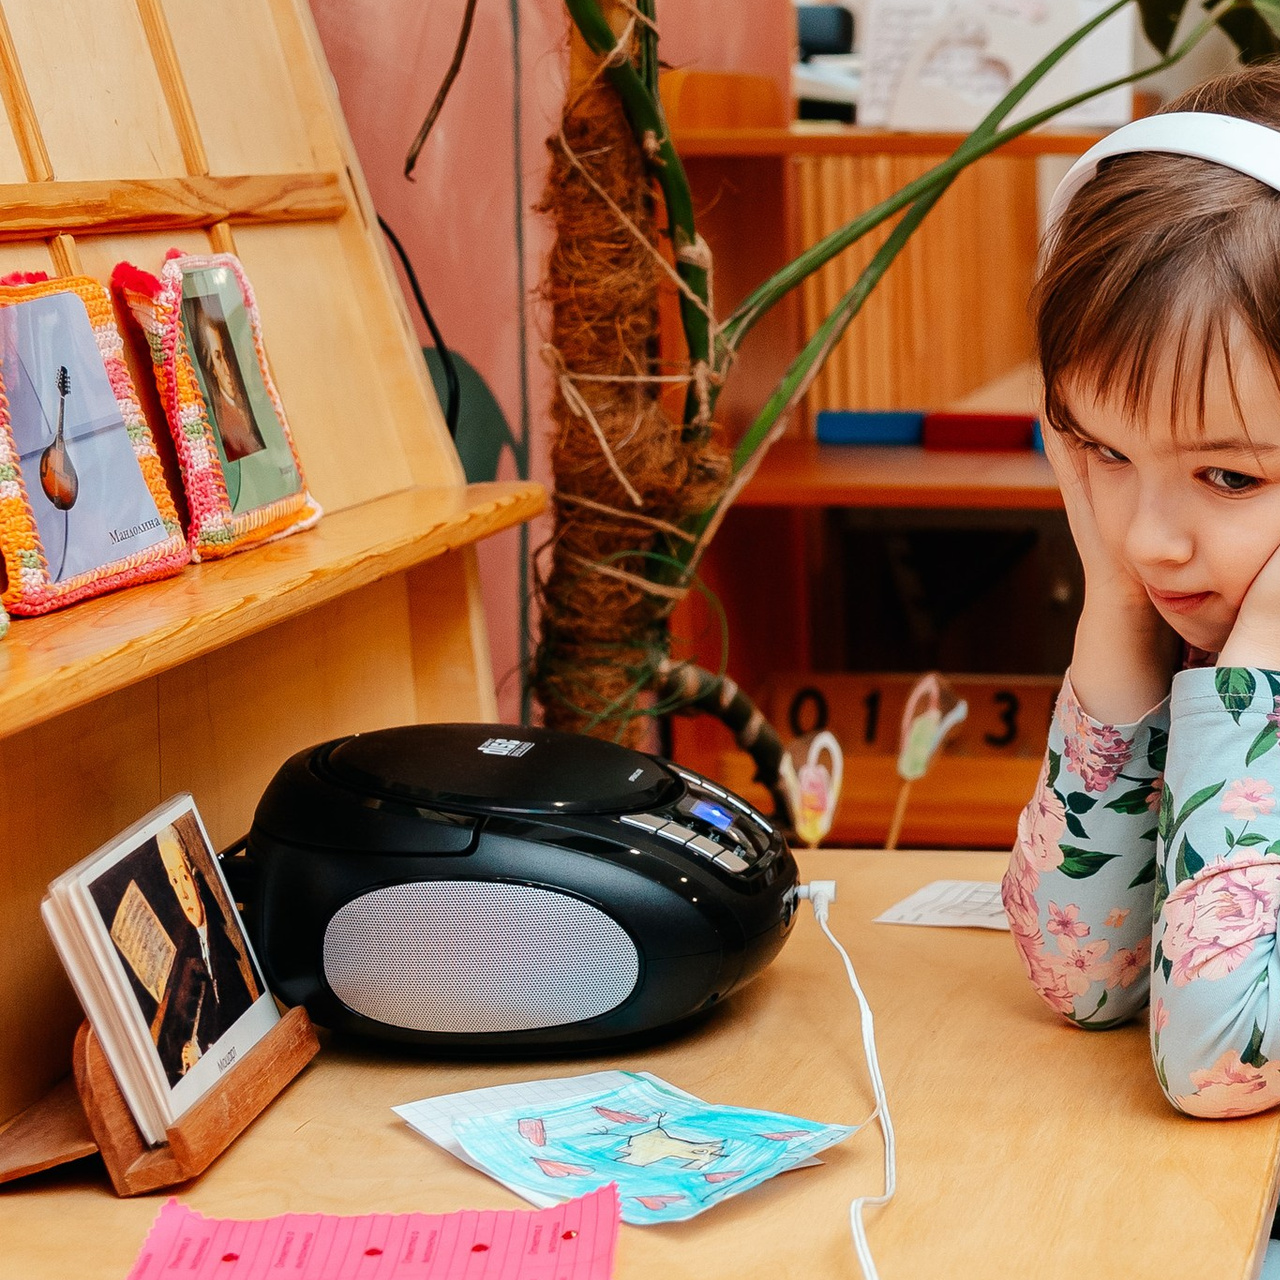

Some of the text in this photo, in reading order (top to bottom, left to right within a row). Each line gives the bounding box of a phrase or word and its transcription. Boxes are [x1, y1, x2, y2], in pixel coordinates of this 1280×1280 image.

[108, 517, 161, 545] Мандолина
[789, 687, 828, 737] 0
[864, 690, 880, 743] 1
[985, 691, 1020, 746] 3
